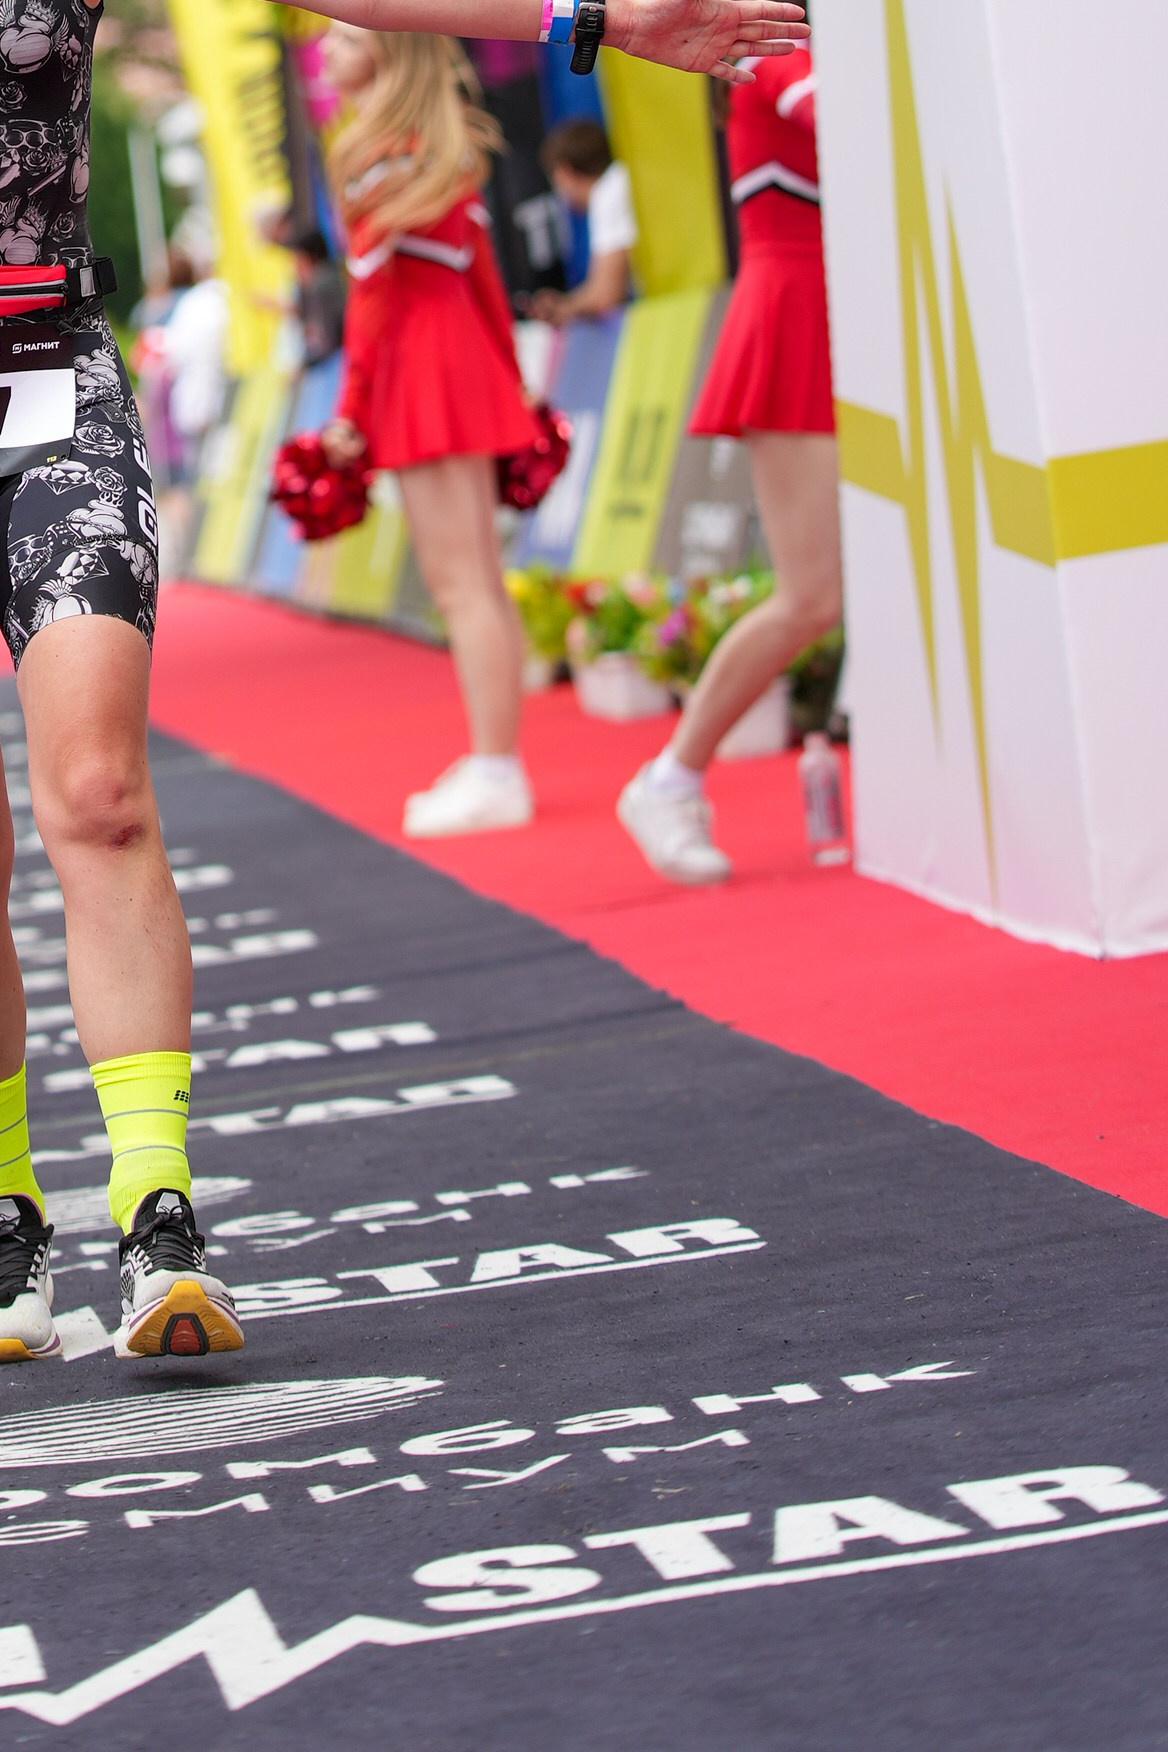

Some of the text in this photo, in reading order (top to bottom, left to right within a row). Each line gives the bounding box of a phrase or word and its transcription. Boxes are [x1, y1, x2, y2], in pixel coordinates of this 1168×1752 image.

[23, 341, 60, 352] МАГНИТ
[232, 1216, 762, 1309] STAR
[410, 1463, 1166, 1613] STAR
